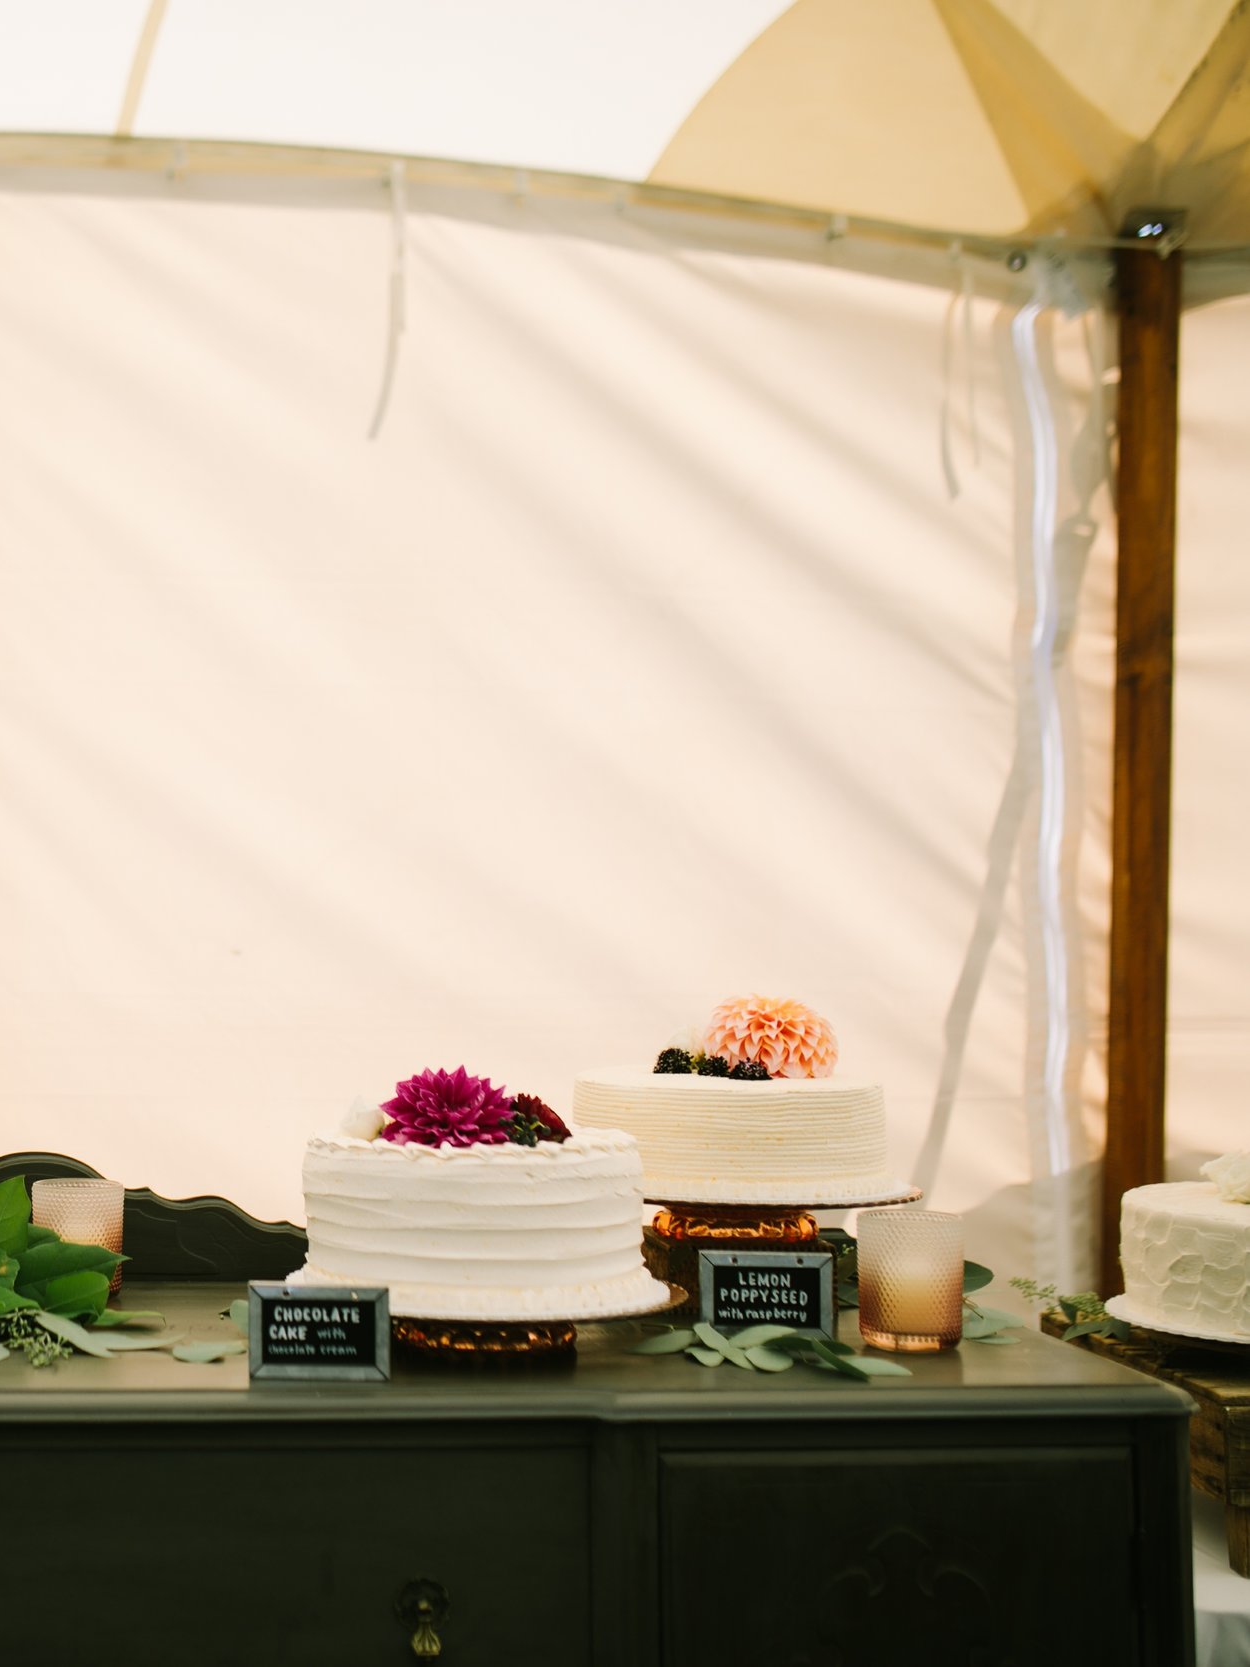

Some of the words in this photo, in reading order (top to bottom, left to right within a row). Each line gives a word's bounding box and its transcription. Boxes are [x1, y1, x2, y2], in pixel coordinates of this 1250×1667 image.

[738, 1271, 791, 1288] LEMON
[720, 1287, 808, 1306] POPPYSEED
[274, 1305, 360, 1324] CHOCOLATE
[718, 1306, 744, 1320] with
[745, 1307, 807, 1323] raspberry
[269, 1324, 308, 1340] CAKE
[316, 1327, 347, 1340] with
[268, 1344, 316, 1355] chocolate
[319, 1345, 358, 1355] cream
